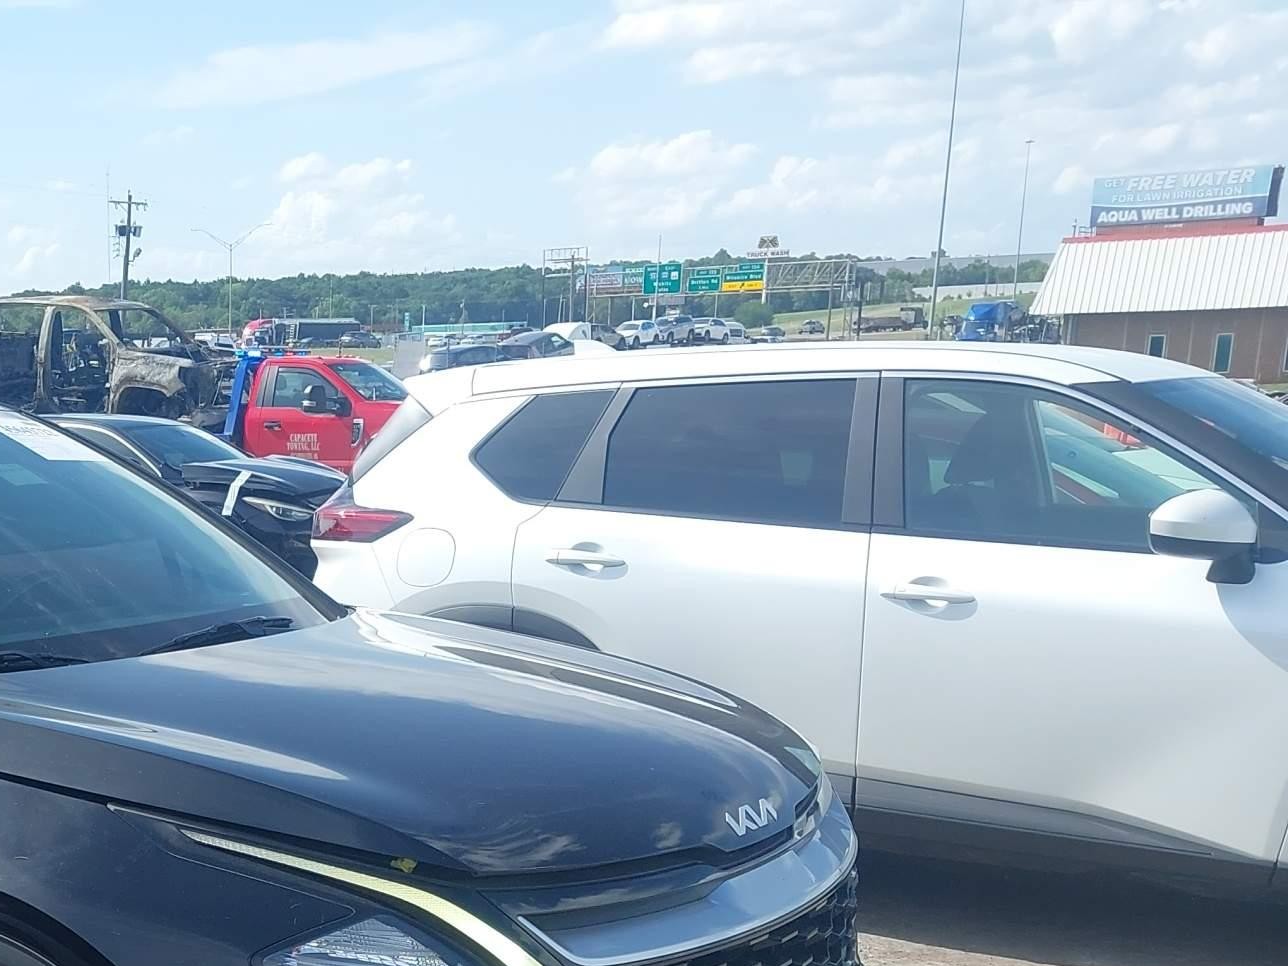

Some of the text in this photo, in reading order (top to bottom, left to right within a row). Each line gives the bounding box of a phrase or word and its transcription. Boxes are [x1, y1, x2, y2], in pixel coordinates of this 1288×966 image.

[1127, 173, 1177, 192] FREE
[1183, 168, 1256, 187] WATER
[1112, 186, 1242, 203] FOR LAWN IRRIGATION
[1097, 202, 1254, 223] AQUA WELL DRILLING
